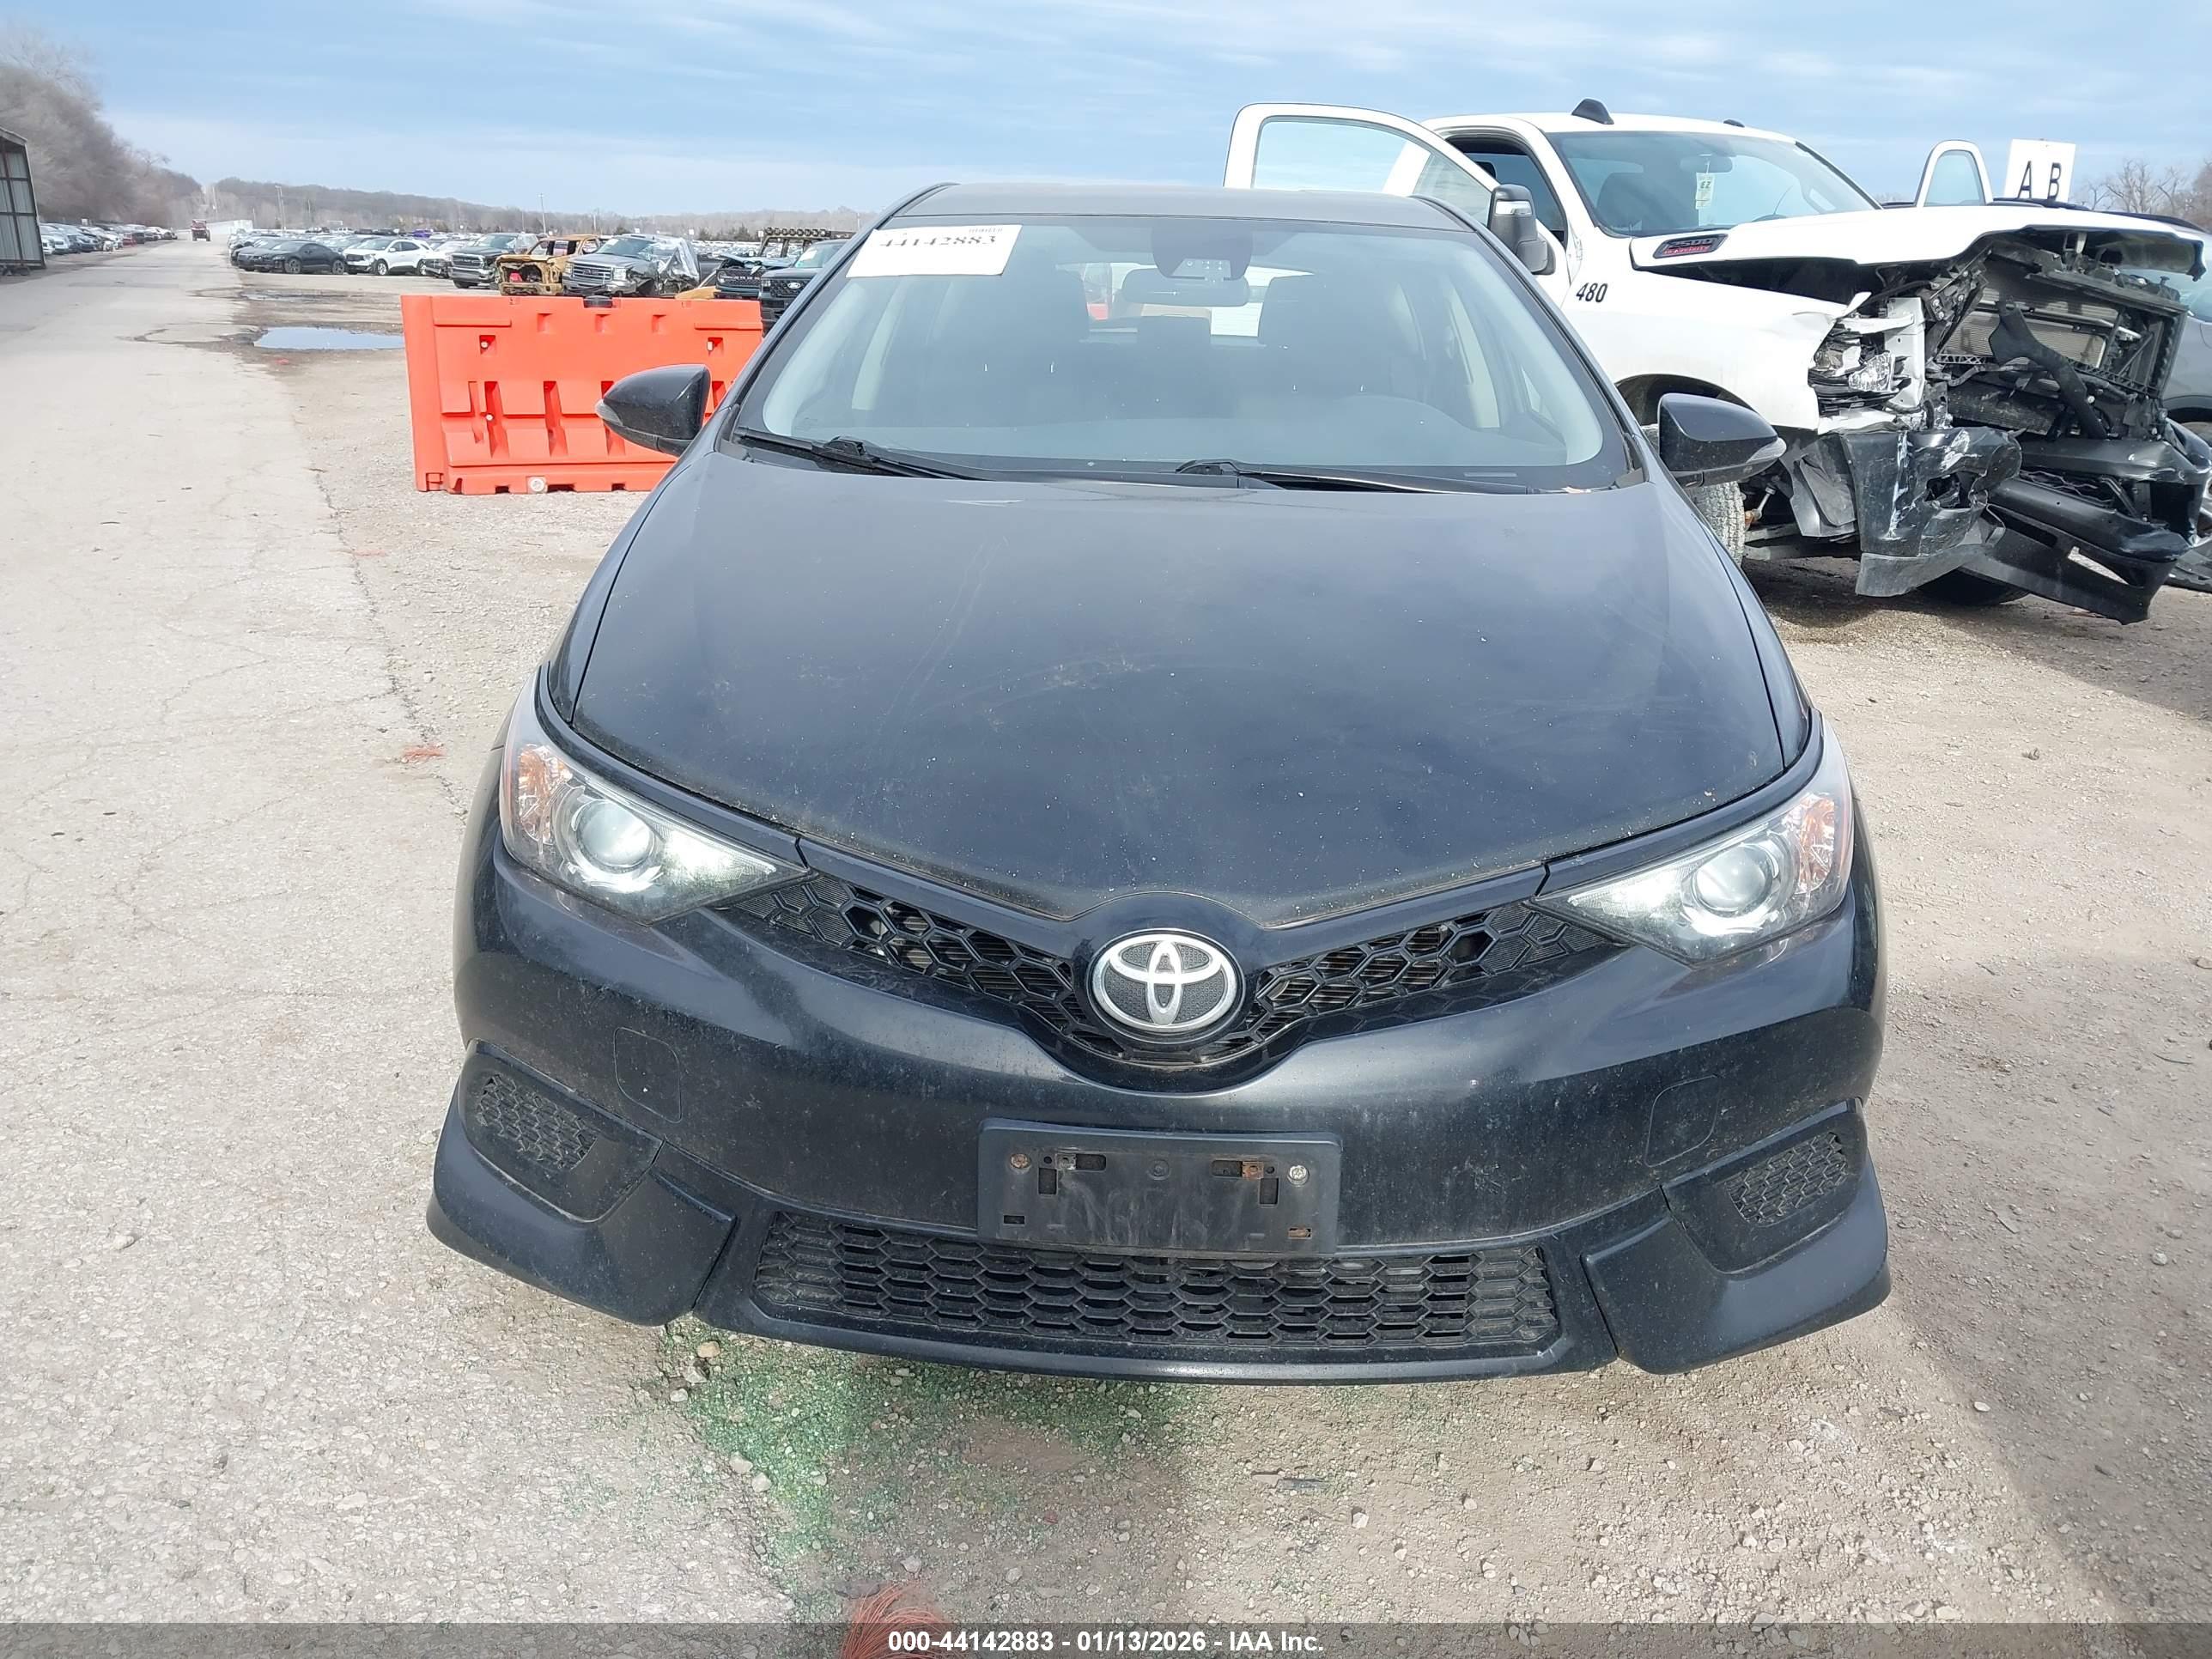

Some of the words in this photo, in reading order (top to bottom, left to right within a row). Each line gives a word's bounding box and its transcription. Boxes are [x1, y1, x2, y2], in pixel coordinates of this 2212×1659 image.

[2017, 161, 2032, 199] A
[2047, 162, 2062, 201] B
[1668, 239, 1712, 249] 2500
[1576, 283, 1608, 303] 480
